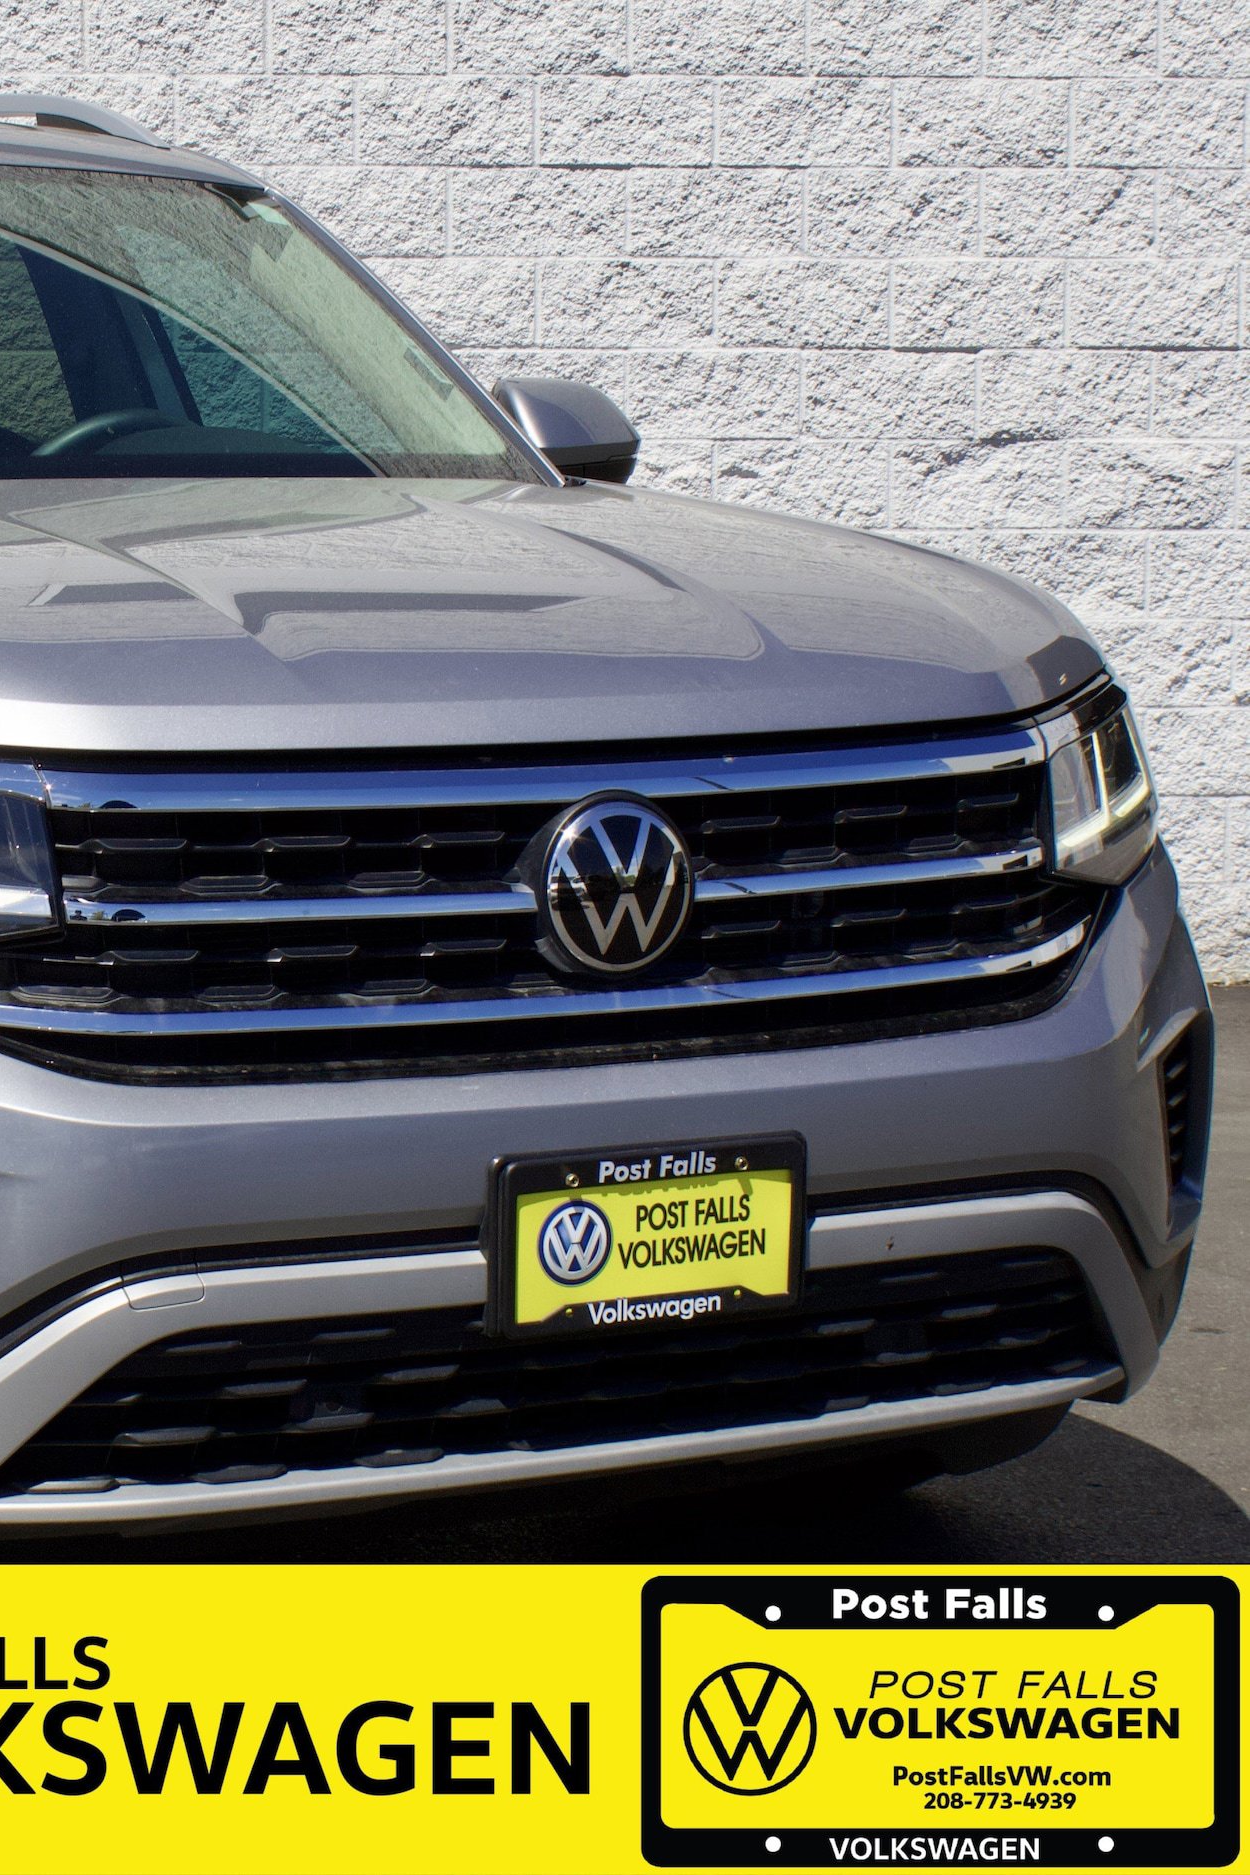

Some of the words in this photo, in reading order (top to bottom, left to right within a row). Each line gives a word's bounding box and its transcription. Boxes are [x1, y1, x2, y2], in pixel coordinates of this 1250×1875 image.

[549, 803, 689, 967] VW
[598, 1159, 651, 1184] Post
[658, 1150, 717, 1178] Falls
[636, 1200, 689, 1232] POST
[694, 1194, 751, 1226] FALLS
[540, 1202, 611, 1283] VW
[617, 1228, 766, 1270] VOLKSWAGEN
[587, 1294, 722, 1326] Volkswagen
